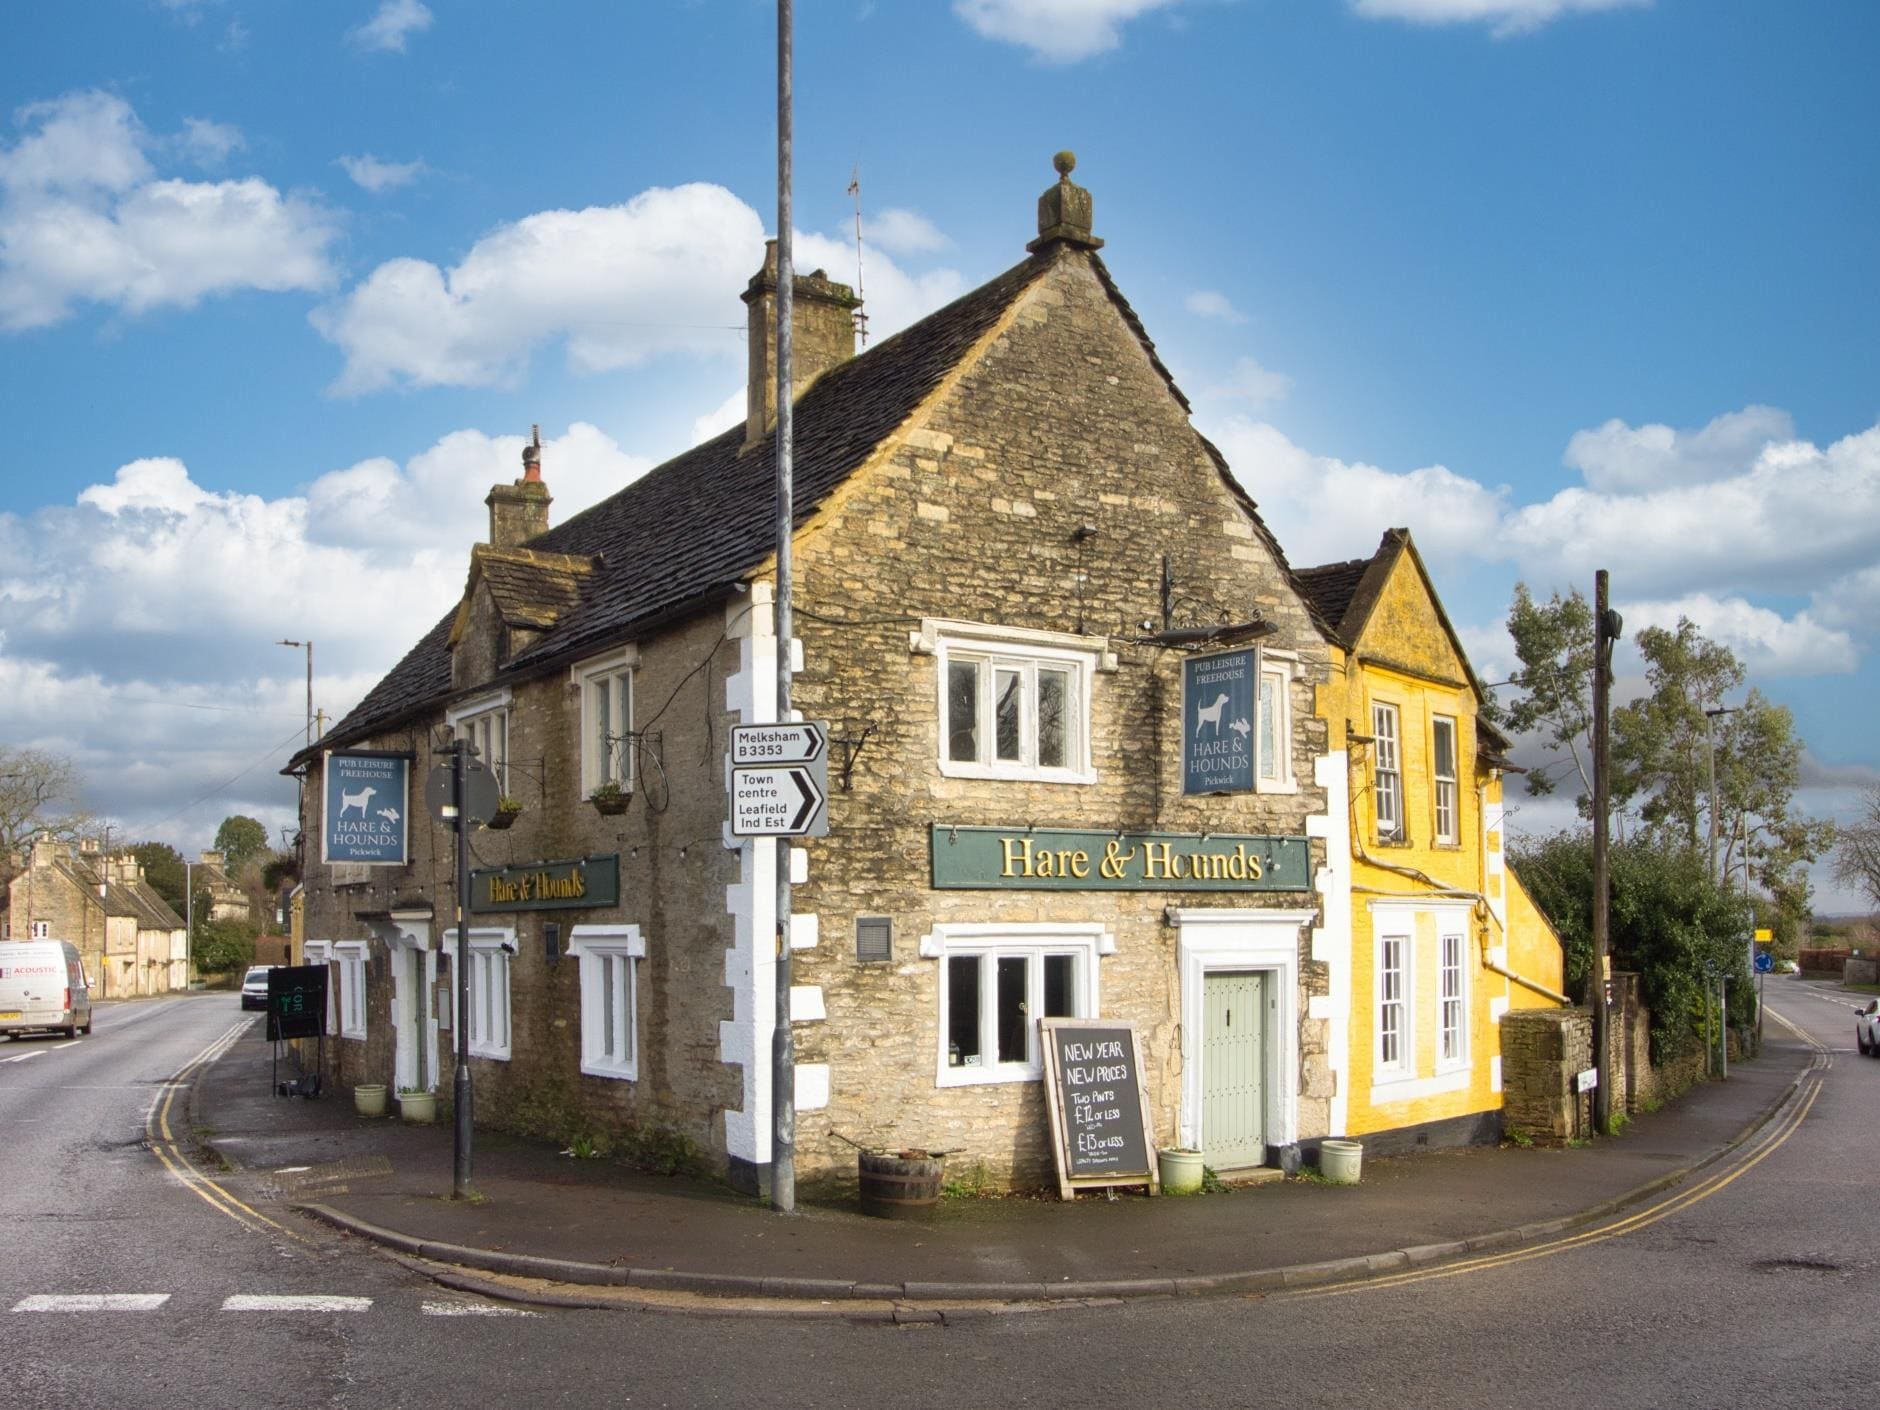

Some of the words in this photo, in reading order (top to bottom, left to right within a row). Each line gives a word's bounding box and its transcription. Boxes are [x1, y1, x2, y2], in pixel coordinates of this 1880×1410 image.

[1194, 662, 1211, 673] PUB
[1212, 655, 1247, 670] LEISURE
[1196, 669, 1245, 685] FREEHOUSE
[738, 731, 800, 743] Melksham
[1193, 739, 1229, 757] HARE
[1232, 736, 1243, 752] &
[339, 759, 357, 768] PUB
[358, 760, 395, 770] LEISURE
[1190, 754, 1249, 774] HOUNDS
[341, 769, 393, 779] FREEHOUSE
[742, 774, 774, 785] Town
[1204, 774, 1234, 786] Pickwick
[738, 788, 778, 798] centre
[739, 803, 787, 815] Leafield
[337, 821, 377, 833] HARE
[380, 821, 392, 833] &
[741, 818, 760, 828] Ind
[765, 816, 785, 828] Est
[333, 833, 398, 846] HOUNDS
[349, 847, 382, 856] Pickwick
[999, 838, 1091, 878] Hare
[1100, 840, 1136, 879] &
[1142, 842, 1263, 881] Hounds
[488, 876, 517, 902] Hare
[519, 872, 531, 901] &
[536, 867, 585, 900] Hounds
[14, 966, 57, 975] ACOUSTIC
[1064, 1043, 1094, 1062] NEW
[1096, 1041, 1125, 1059] YEAR
[1066, 1067, 1095, 1085] NEW
[1096, 1065, 1127, 1083] PRICES
[1073, 1104, 1094, 1125] £12
[1104, 1108, 1120, 1120] LESS
[1107, 1136, 1124, 1148] LESS
